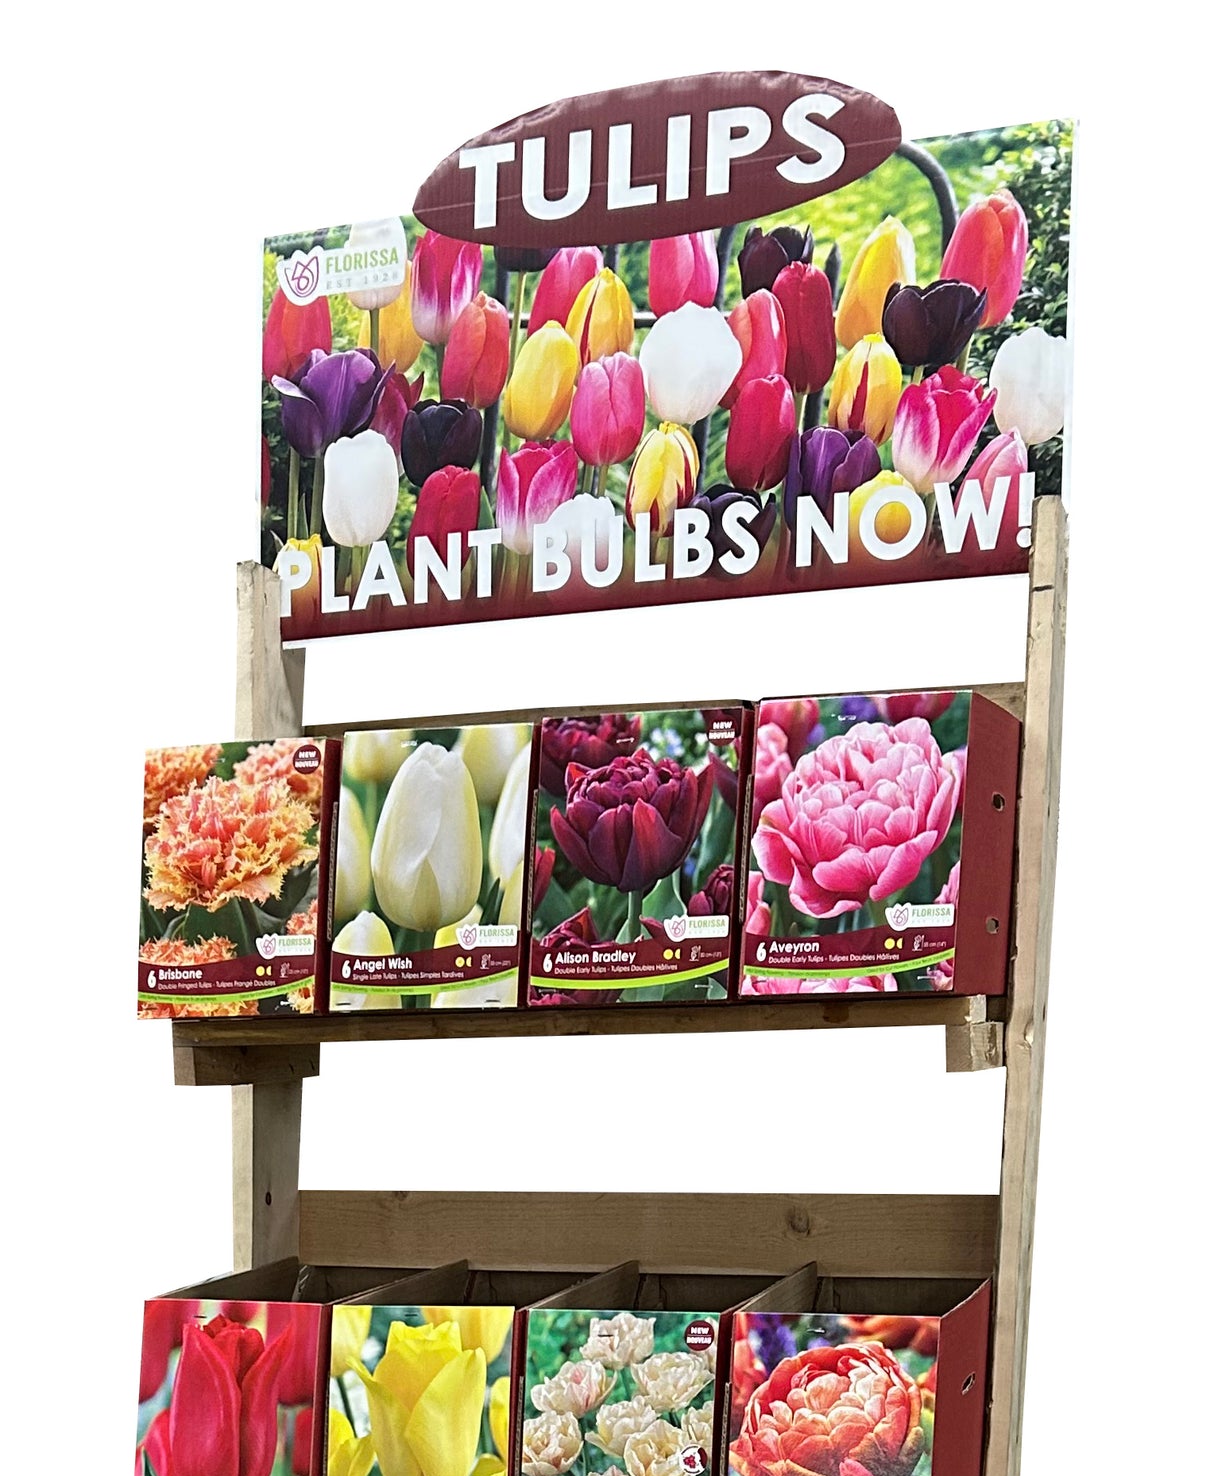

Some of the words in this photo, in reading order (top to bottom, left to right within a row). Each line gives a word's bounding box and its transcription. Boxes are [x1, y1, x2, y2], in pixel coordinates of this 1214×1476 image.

[458, 94, 846, 230] TULIPS
[326, 247, 399, 274] FLORISSA
[327, 279, 351, 289] EST
[279, 528, 502, 618] PLANT
[533, 501, 762, 592] BULBS
[798, 473, 1037, 568] NOW!
[713, 721, 732, 729] NEW
[912, 907, 950, 916] FLORISSA
[689, 919, 725, 928] FLORISSA
[479, 928, 514, 937] FLORISSA
[278, 938, 312, 946] FLORISSA
[756, 942, 766, 961] 6
[769, 941, 819, 955] Aveyron
[543, 954, 552, 972] 6
[555, 952, 589, 964] Alison
[593, 951, 636, 964] Bradley
[792, 956, 806, 964] Early
[808, 955, 824, 963] Tulips
[342, 960, 350, 978] 6
[353, 959, 386, 971] Angel
[388, 958, 412, 969] Wish
[577, 967, 590, 975] Early
[611, 965, 630, 973] Tulipes
[631, 964, 655, 972] Doubles
[148, 970, 156, 988] 6
[159, 969, 202, 980] Brisbane
